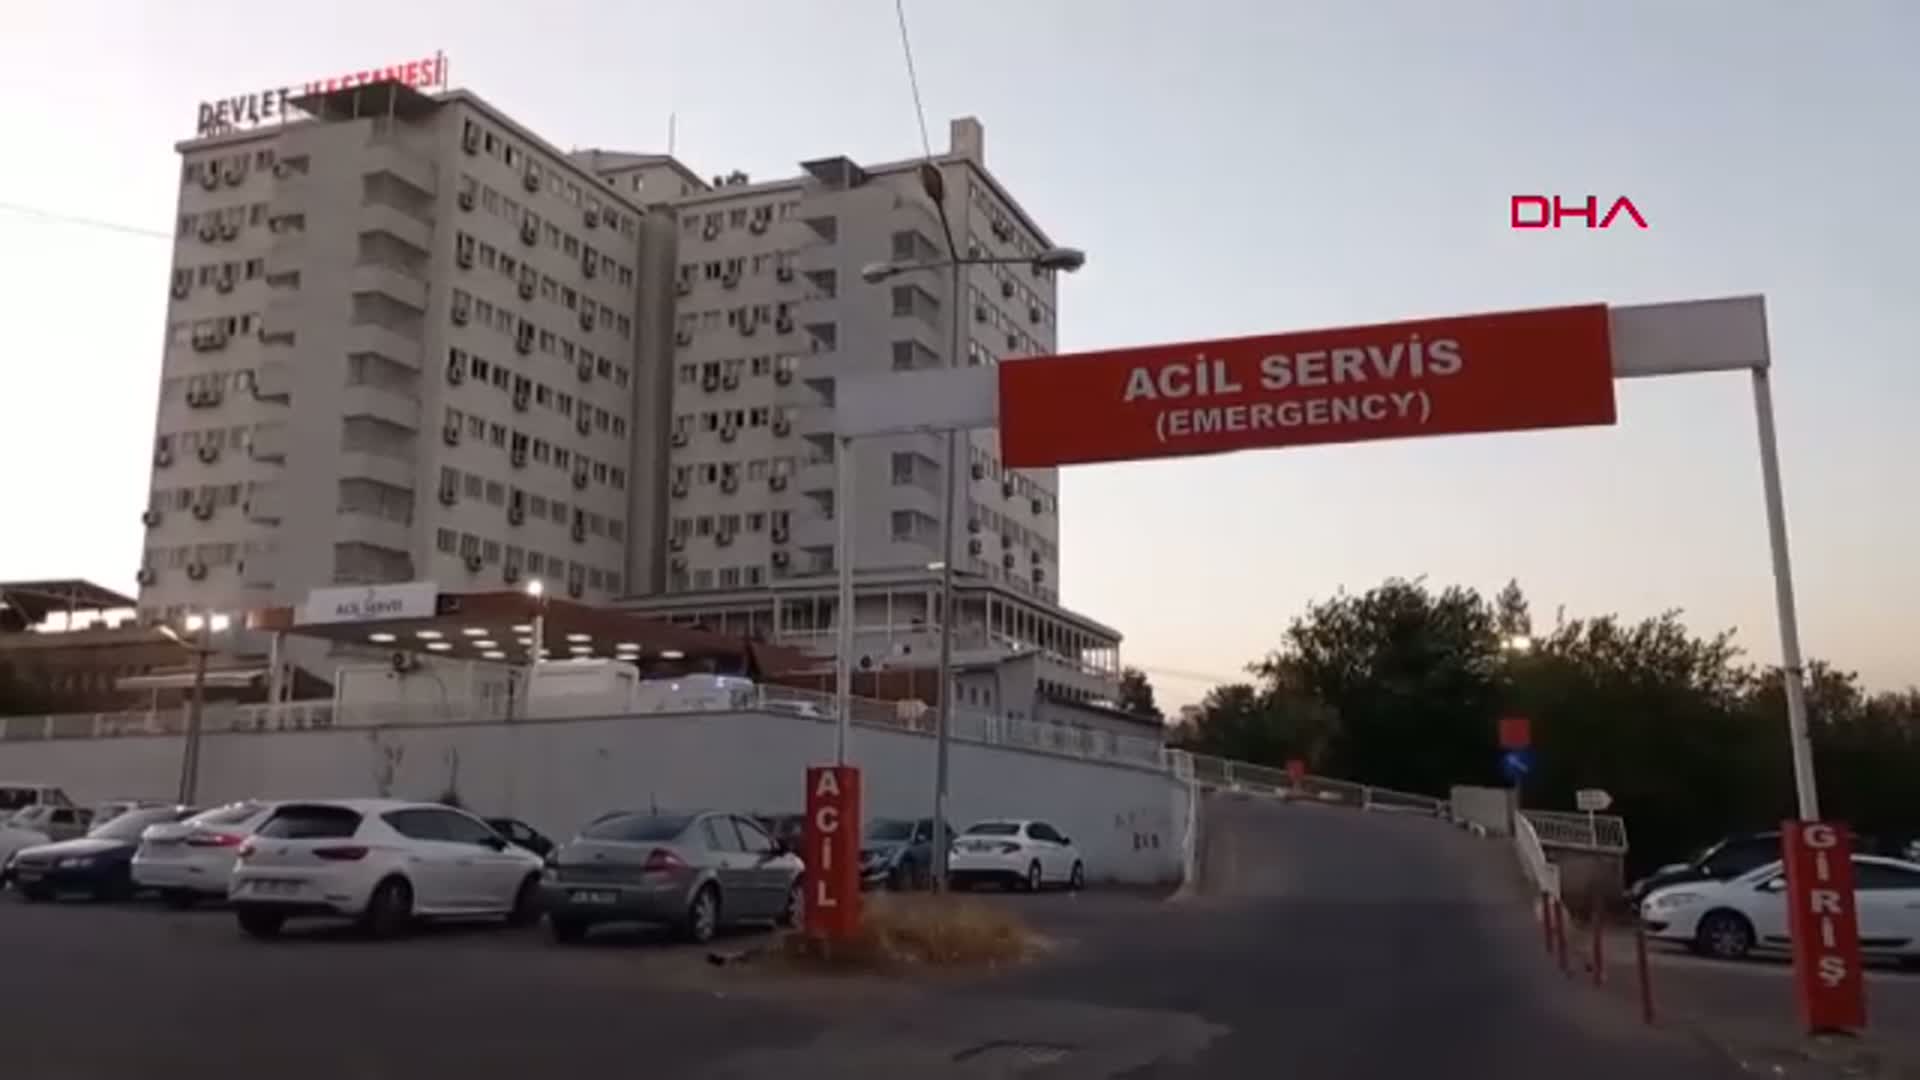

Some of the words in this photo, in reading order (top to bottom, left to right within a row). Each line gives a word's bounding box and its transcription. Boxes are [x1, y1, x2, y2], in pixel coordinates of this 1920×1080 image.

[198, 88, 289, 131] DEVLET
[1124, 353, 1242, 401] ACİL
[1260, 333, 1463, 389] SERVİS
[1155, 390, 1431, 442] (EMERGENCY)
[815, 769, 840, 907] ACİL
[1803, 824, 1847, 988] GİRİŞ
